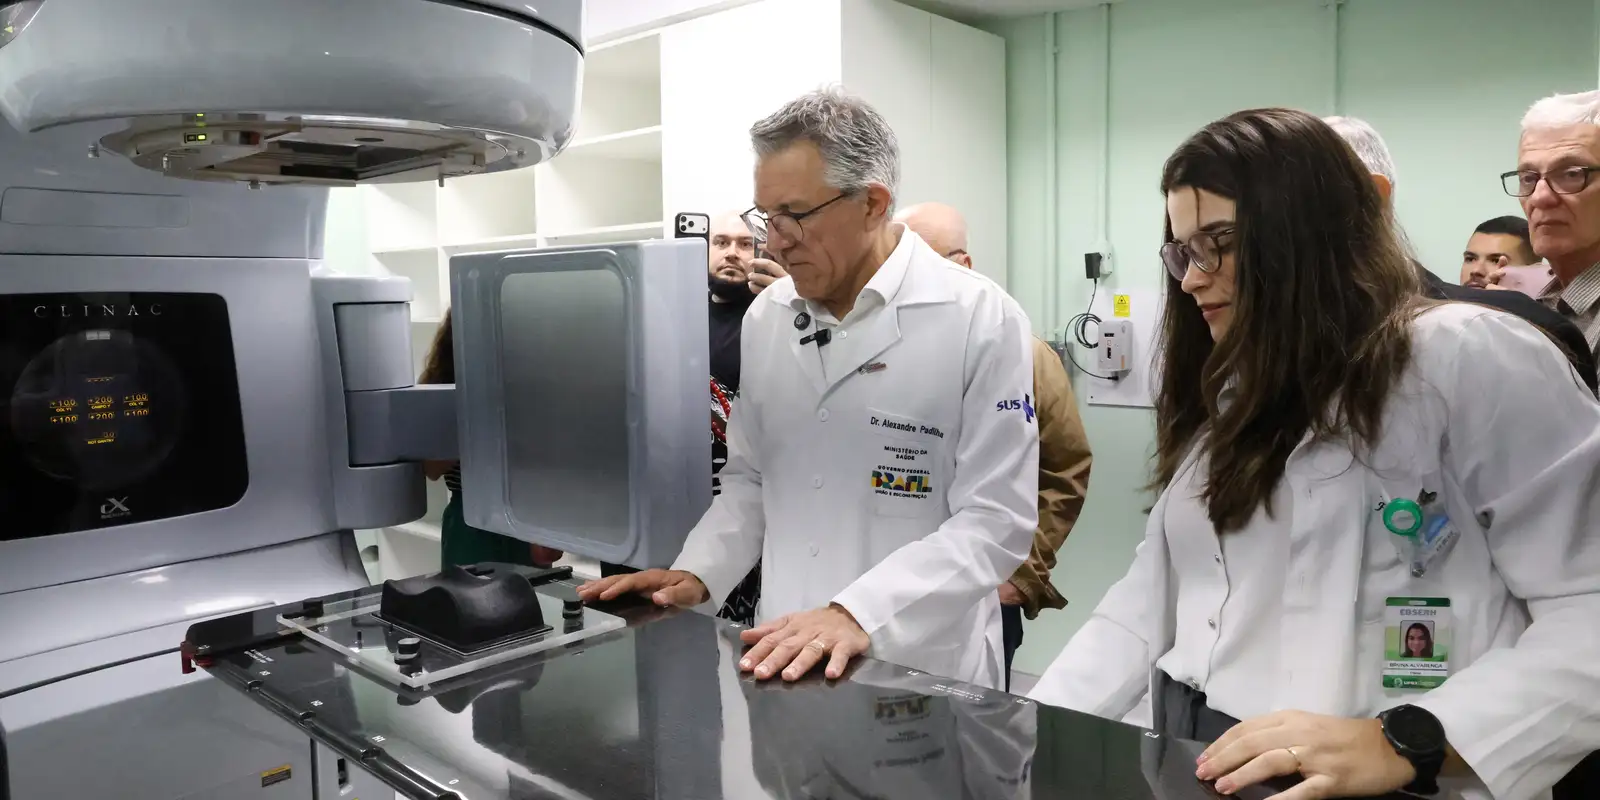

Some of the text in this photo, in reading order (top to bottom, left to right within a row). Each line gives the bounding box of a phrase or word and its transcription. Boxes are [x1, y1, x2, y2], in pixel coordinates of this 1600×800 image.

[34, 304, 161, 318] CLINAC
[996, 399, 1021, 411] SUS
[870, 416, 944, 438] Dr. Alexandre Padilha
[877, 465, 905, 473] GOVERNO
[871, 470, 932, 492] BRASIL
[1399, 608, 1437, 616] EBSERH
